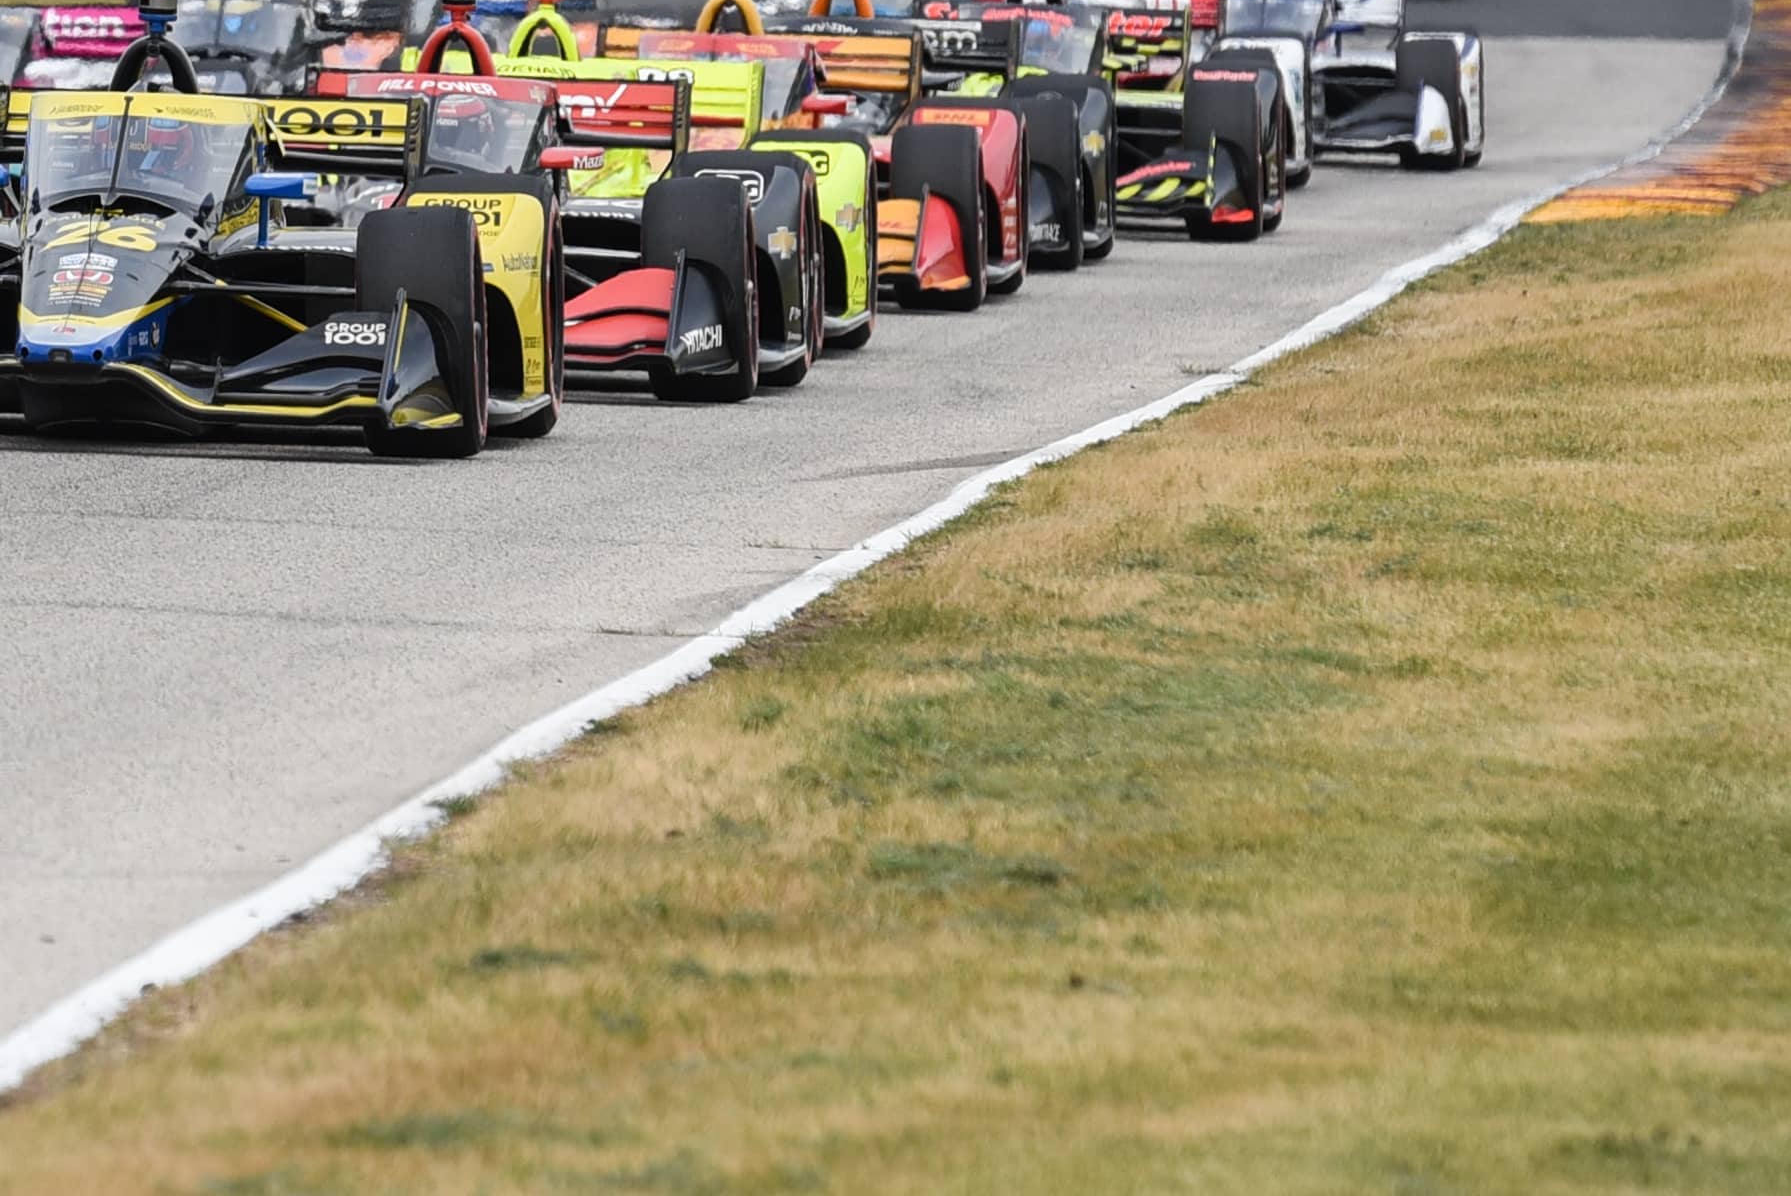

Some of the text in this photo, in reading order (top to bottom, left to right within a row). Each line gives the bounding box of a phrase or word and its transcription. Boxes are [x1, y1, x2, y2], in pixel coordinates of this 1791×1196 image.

[420, 80, 498, 97] POWER
[40, 219, 158, 253] 26
[324, 322, 386, 333] GROUP
[324, 331, 386, 345] 1001
[679, 324, 723, 355] HITACHI
